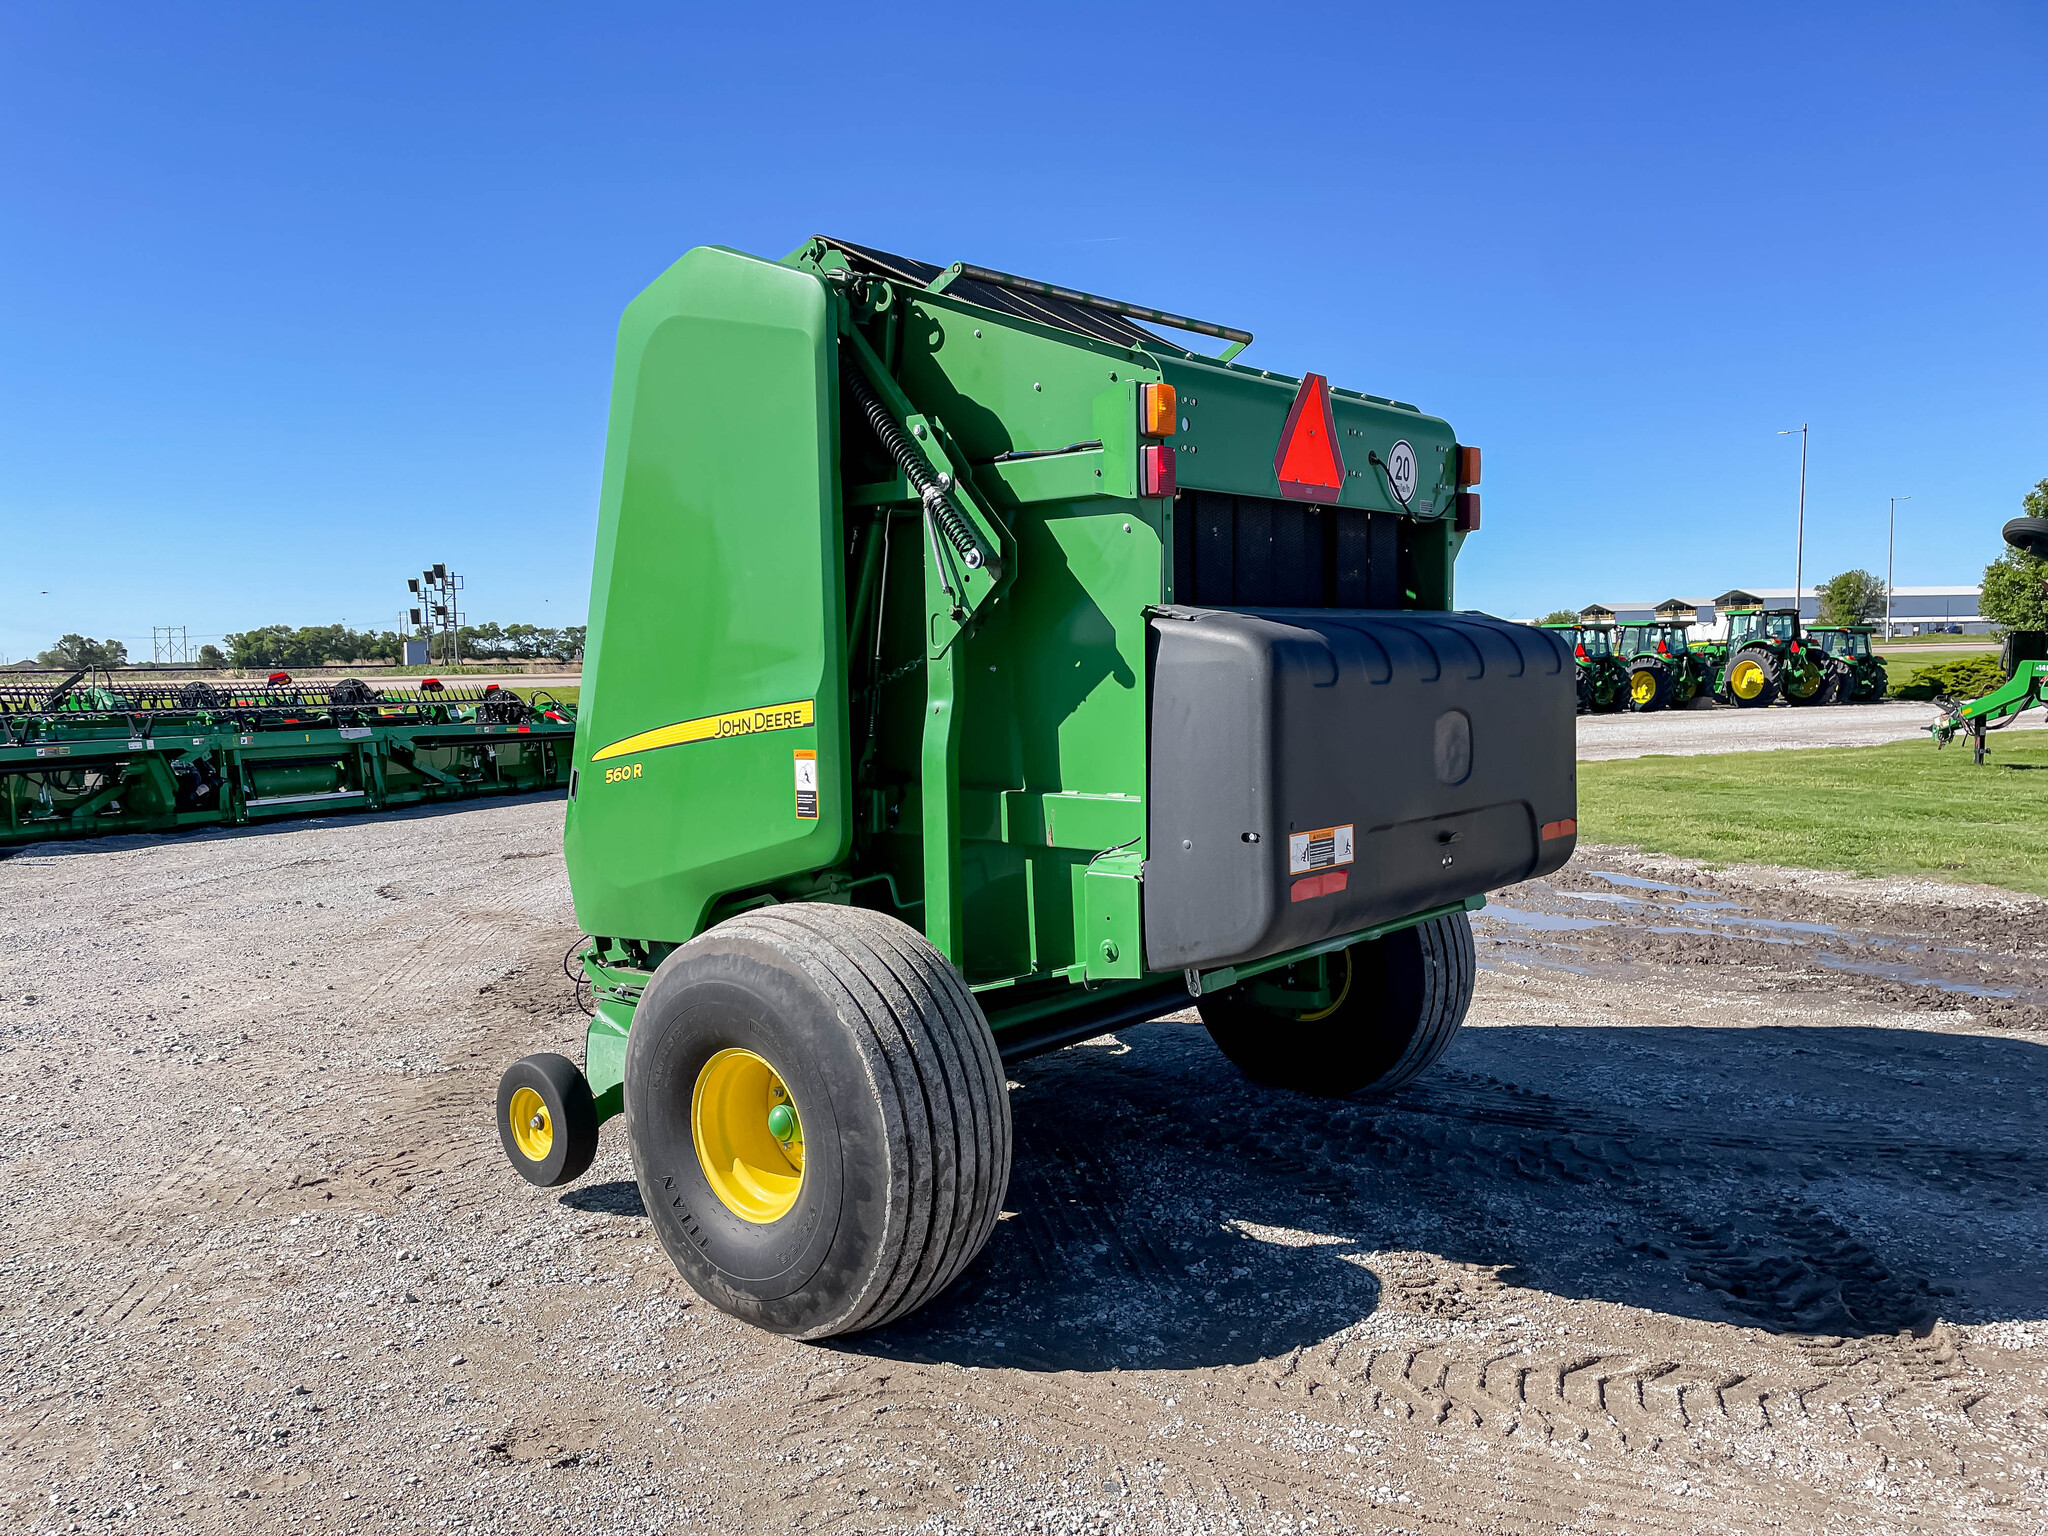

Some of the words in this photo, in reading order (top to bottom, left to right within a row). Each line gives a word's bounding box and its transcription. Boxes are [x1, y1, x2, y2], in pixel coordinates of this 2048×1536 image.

[1395, 455, 1410, 482] 20
[714, 716, 751, 736] JOHN
[754, 710, 802, 730] DEERE
[605, 764, 631, 784] 560
[633, 762, 643, 780] R
[661, 1175, 713, 1254] TITAN
